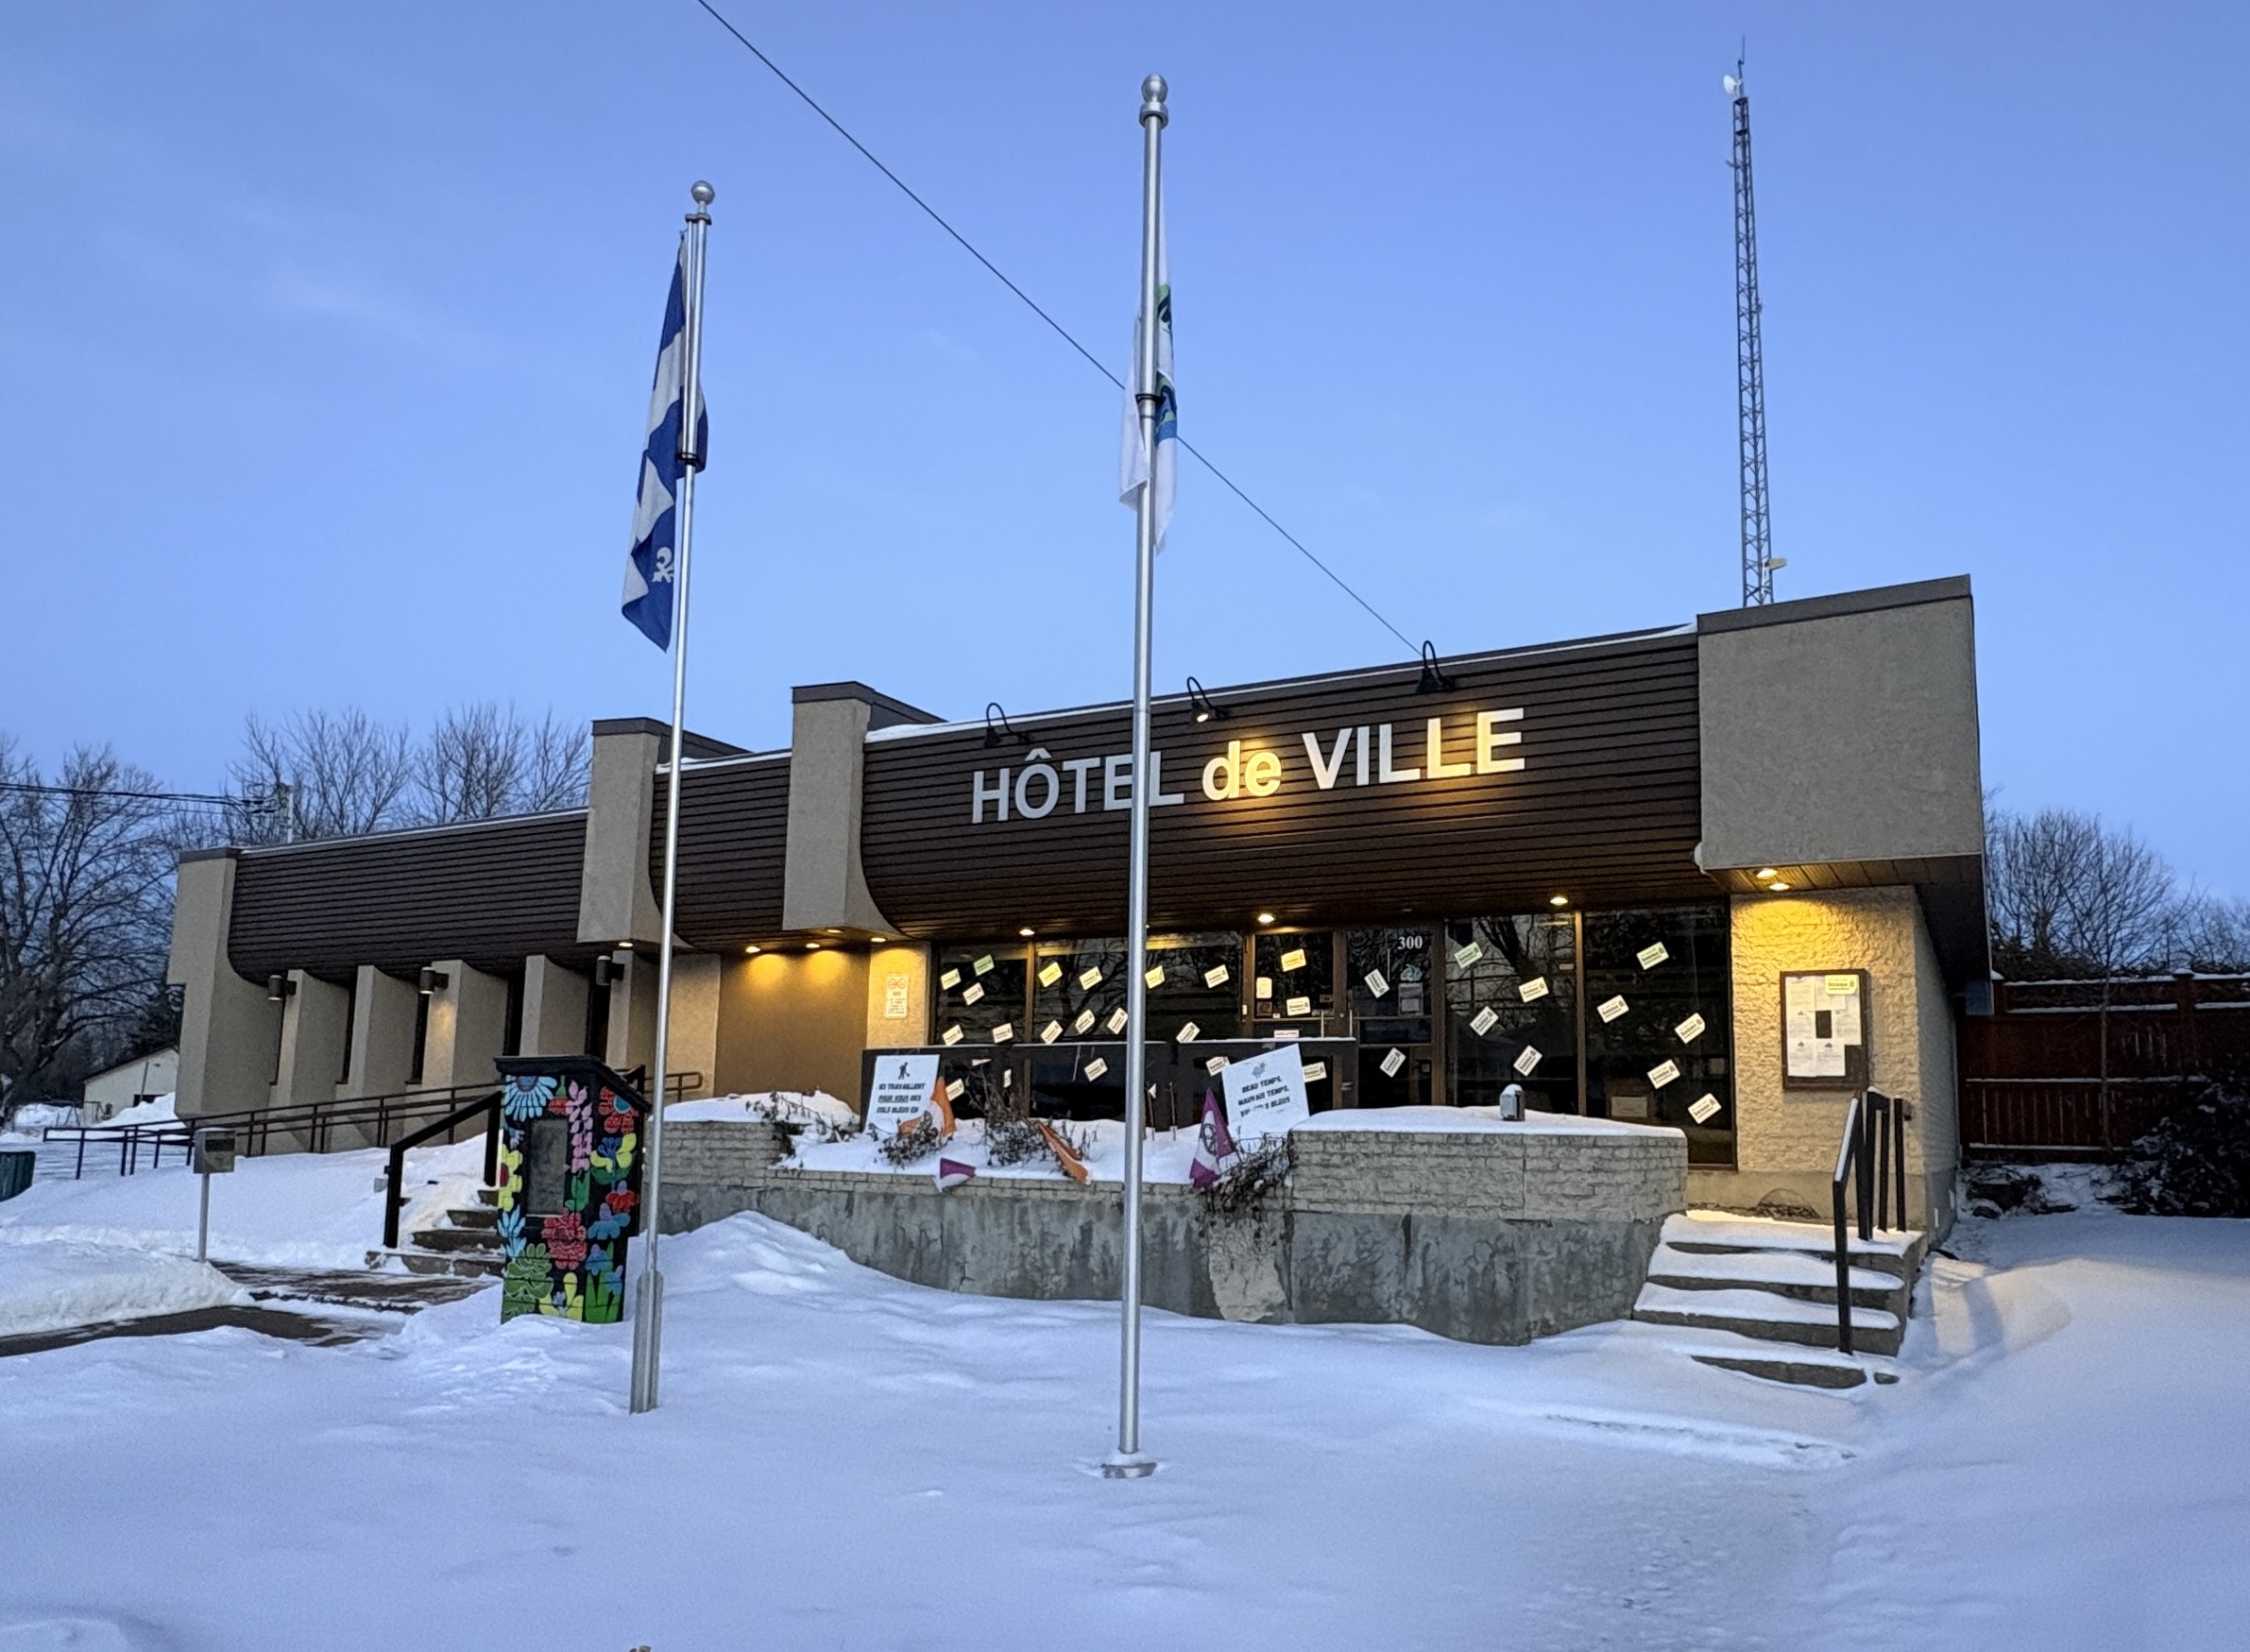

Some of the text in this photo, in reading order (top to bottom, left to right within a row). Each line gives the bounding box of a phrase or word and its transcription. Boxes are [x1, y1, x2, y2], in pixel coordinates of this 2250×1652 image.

[972, 707, 1526, 824] HÔTEL de VILLE
[1397, 935, 1423, 950] 300
[1241, 1082, 1258, 1093] BEAU
[1238, 1092, 1265, 1105] MAUVAIS
